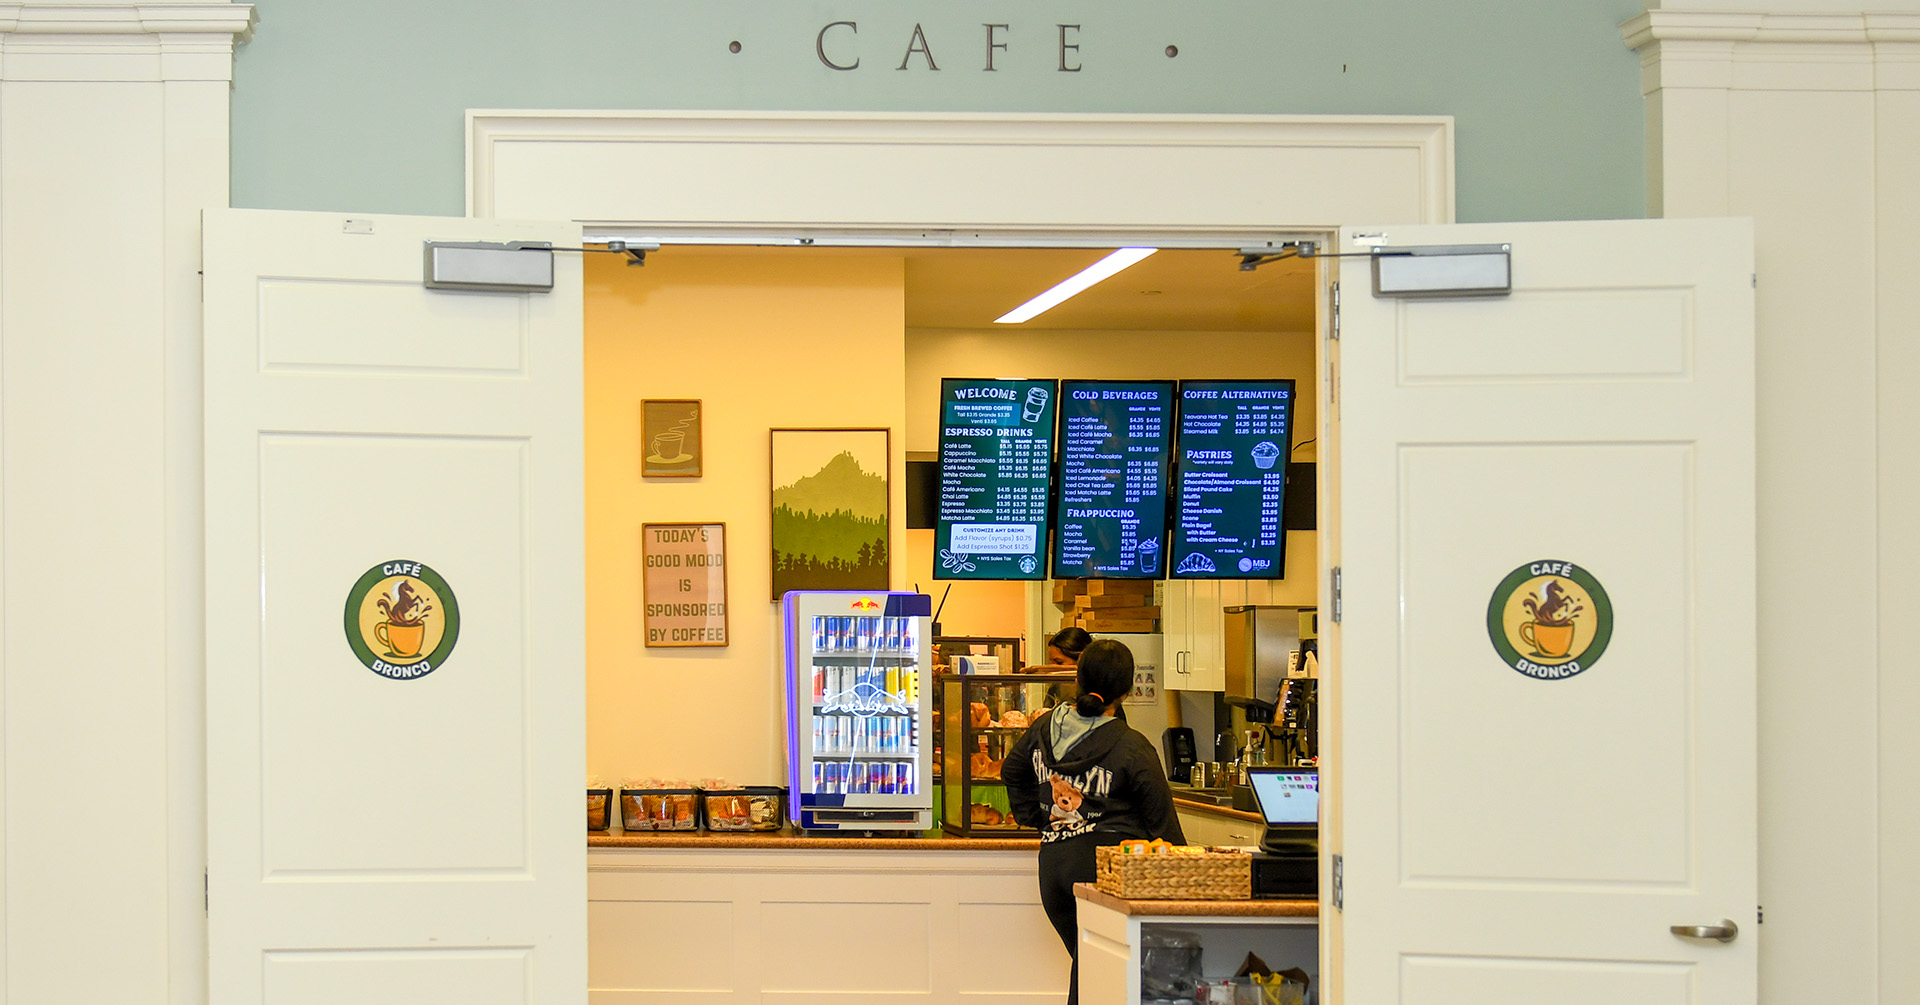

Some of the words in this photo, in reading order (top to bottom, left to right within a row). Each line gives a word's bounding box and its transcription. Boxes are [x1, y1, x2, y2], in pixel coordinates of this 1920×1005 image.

[816, 22, 1082, 72] CAFE
[955, 388, 1017, 400] WELCOME
[1073, 391, 1098, 399] COLD
[1103, 391, 1158, 399] BEVERAGES
[1187, 451, 1232, 459] PASTRIES
[1067, 509, 1134, 517] FRAPPUCCINO
[655, 529, 709, 543] TODAY'S
[646, 555, 680, 567] GOOD
[686, 555, 723, 567] MOOD
[383, 563, 422, 577] CAFÉ
[1530, 562, 1572, 577] CAFÉ
[680, 579, 691, 591] IS
[647, 604, 725, 617] SPONSORED
[650, 629, 666, 641] BY
[672, 628, 724, 641] COFFEE
[372, 659, 431, 678] BRONCO
[1516, 659, 1580, 678] BRONCO
